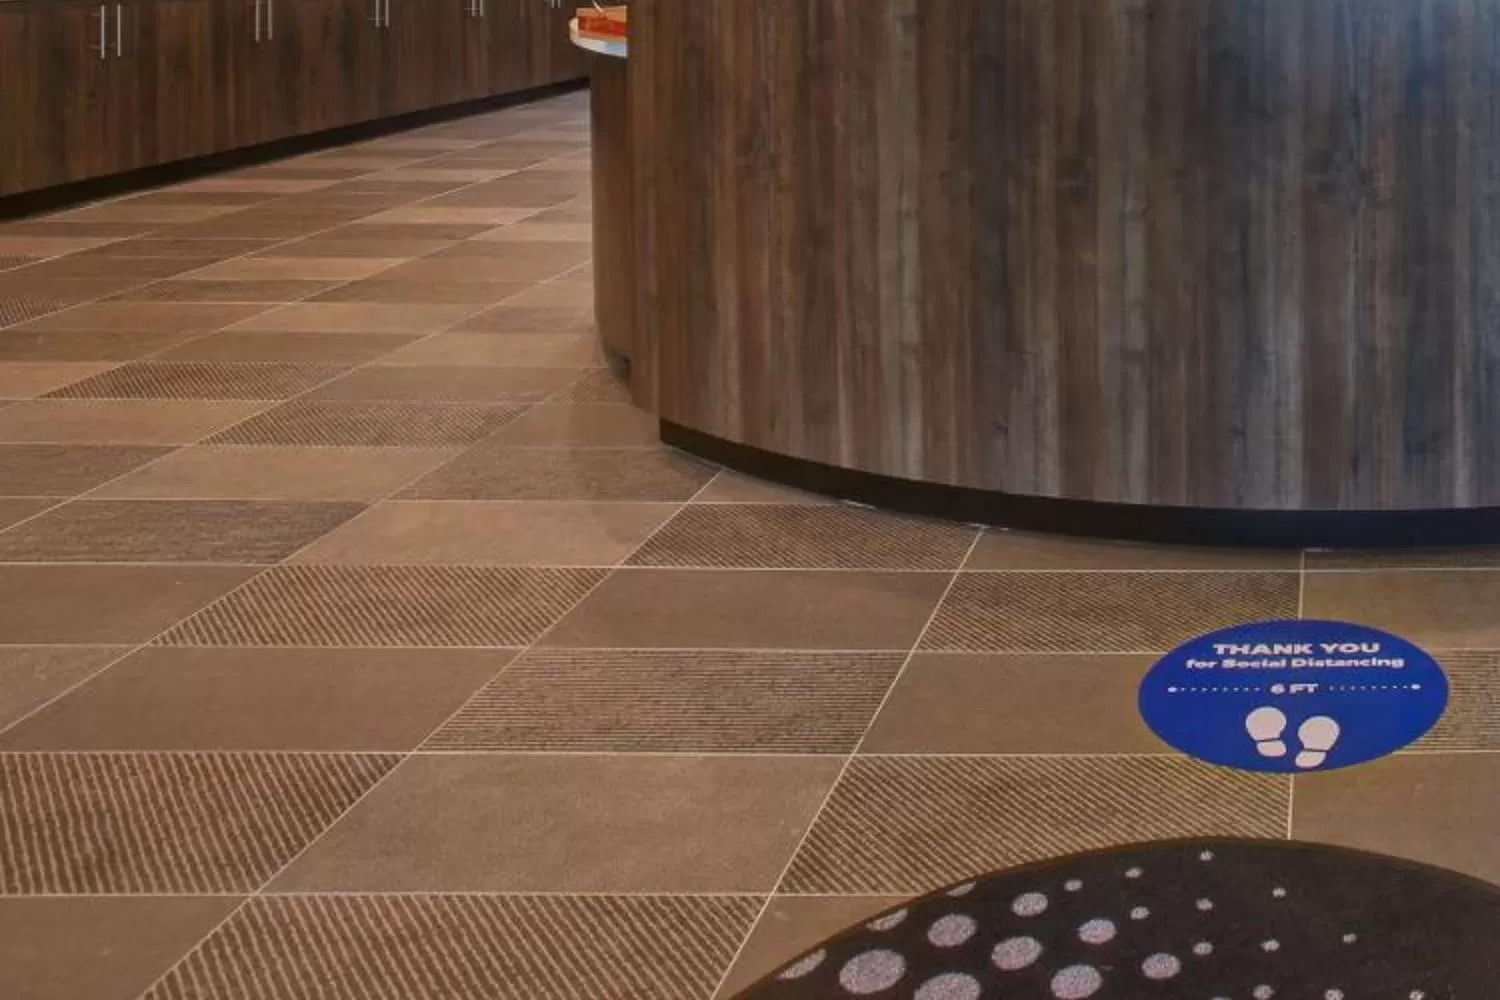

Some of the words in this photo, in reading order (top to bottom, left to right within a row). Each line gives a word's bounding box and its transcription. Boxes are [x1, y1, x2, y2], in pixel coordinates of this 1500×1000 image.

[1212, 643, 1314, 656] THANK
[1319, 642, 1381, 655] YOU
[1186, 659, 1218, 670] for
[1221, 658, 1287, 669] Social
[1291, 656, 1406, 669] Distancing
[1269, 683, 1286, 695] 6
[1289, 683, 1319, 695] FT
